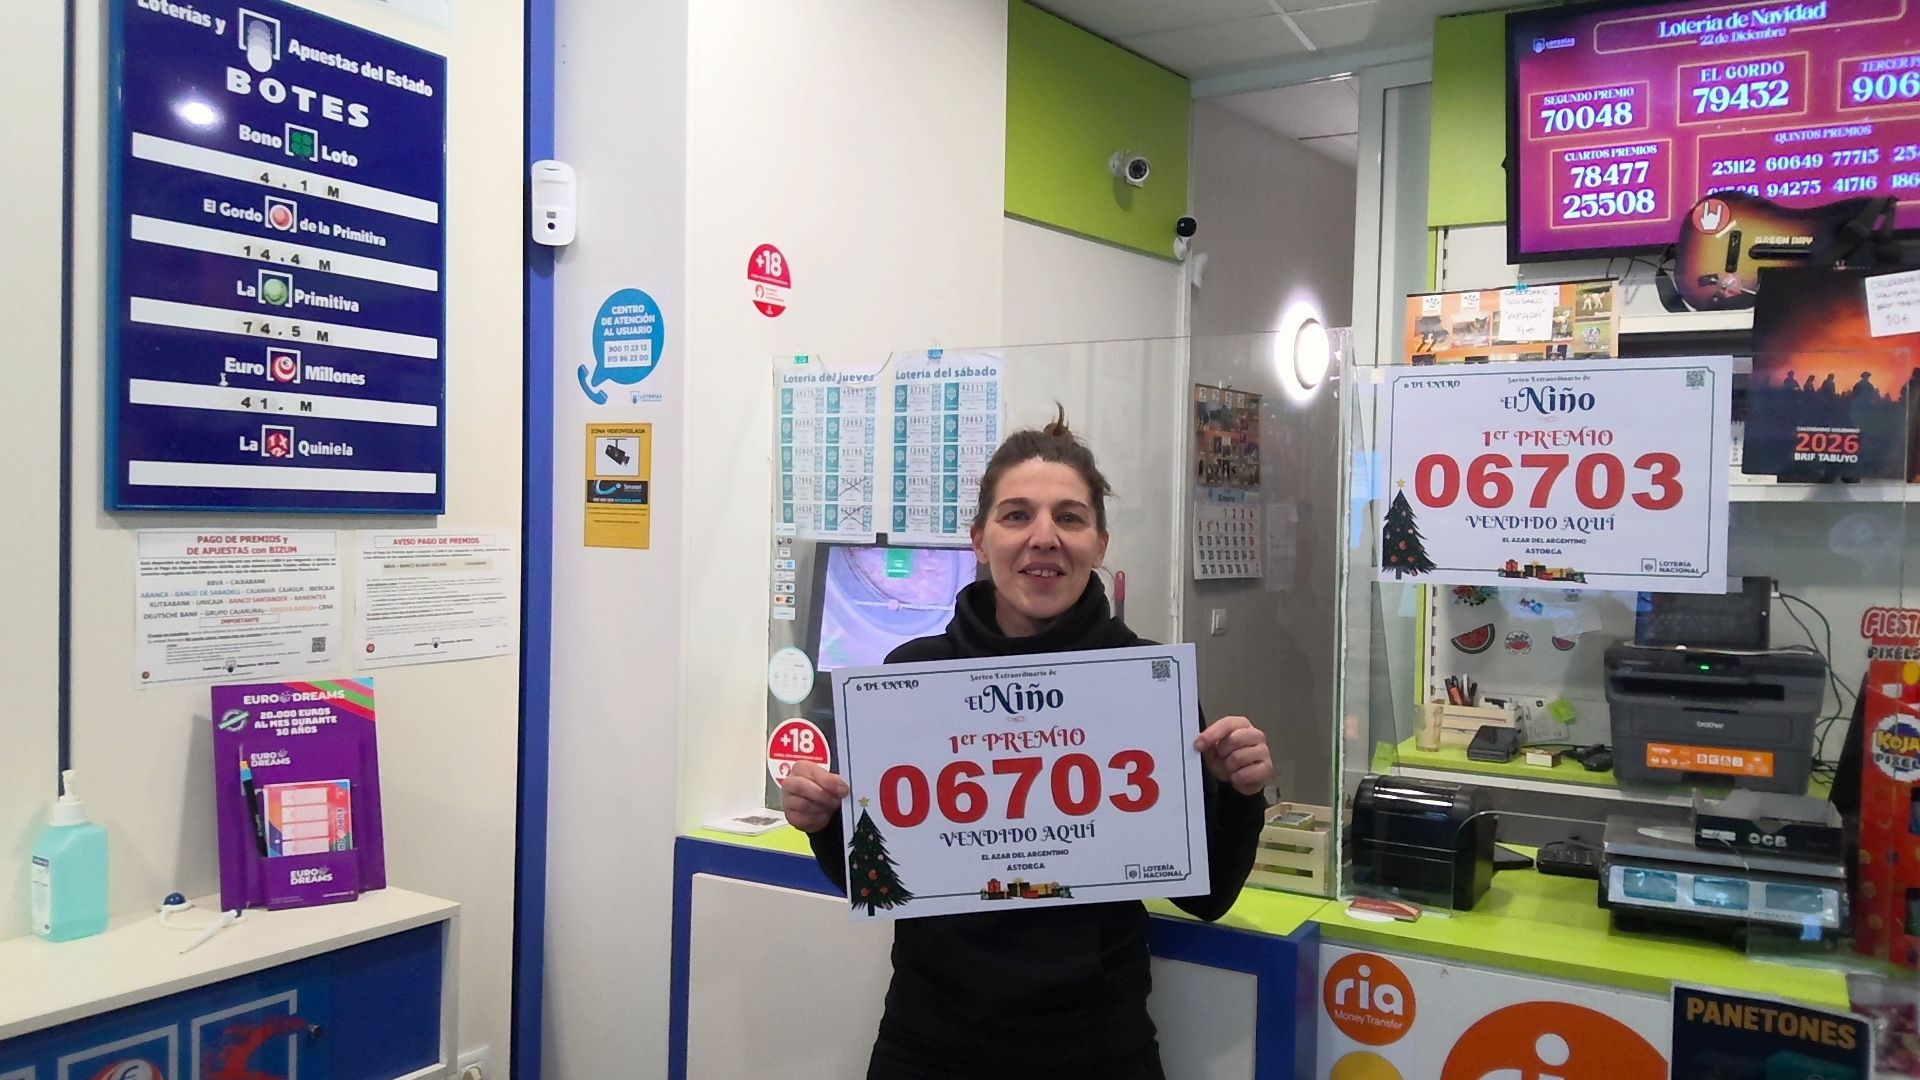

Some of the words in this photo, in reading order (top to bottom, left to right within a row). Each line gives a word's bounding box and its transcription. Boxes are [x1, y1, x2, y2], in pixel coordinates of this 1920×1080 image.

[1725, 12, 1749, 28] de
[1750, 1, 1828, 26] Navidad
[1700, 34, 1714, 46] 22
[1715, 31, 1729, 44] de
[1731, 27, 1787, 42] Diciembre
[137, 0, 211, 26] Loterías
[214, 18, 226, 35] y
[288, 39, 358, 74] Apuestas
[361, 61, 383, 82] del
[386, 71, 433, 97] Estado
[1701, 68, 1722, 82] EL
[1725, 61, 1785, 80] GORDO
[1852, 71, 1920, 102] 906
[227, 66, 369, 128] BOTES
[1544, 91, 1592, 105] SEGUNDO
[1594, 87, 1634, 100] PREMIO
[1692, 79, 1789, 114] 79432
[1540, 101, 1633, 133] 70048
[1775, 128, 1821, 144] QUINTOS
[1823, 125, 1872, 139] PREMIOS
[239, 125, 282, 149] Bono
[322, 145, 358, 167] Loto
[1564, 148, 1610, 161] CUARTOS
[1611, 144, 1657, 157] PREMIOS
[1765, 153, 1823, 172] 60649
[1832, 148, 1879, 166] 77715
[1571, 161, 1649, 188] 78477
[327, 184, 340, 199] M
[1833, 176, 1877, 193] 41716
[1562, 189, 1655, 219] 25508
[203, 198, 216, 213] El
[220, 202, 263, 223] Gordo
[300, 218, 316, 234] de
[318, 221, 330, 236] la
[333, 224, 386, 247] Primitiva
[1755, 235, 1789, 245] GREEN
[319, 258, 331, 272] M
[755, 250, 783, 277] +18
[237, 280, 256, 298] La
[294, 291, 360, 313] Primitiva
[611, 304, 645, 315] CENTRO
[601, 317, 612, 326] DE
[614, 313, 656, 325] ATENCIÓN
[316, 329, 329, 342] M
[604, 328, 615, 336] AL
[616, 325, 653, 336] USUARIO
[224, 357, 265, 376] Euro
[305, 366, 366, 386] Millones
[838, 373, 875, 385] jueves
[895, 369, 931, 380] Lotería
[933, 367, 952, 378] del
[954, 366, 997, 378] sábado
[1411, 381, 1425, 389] DE
[1426, 380, 1461, 389] ENERO
[300, 400, 313, 413] M
[1500, 395, 1518, 410] El
[1517, 385, 1596, 415] Niño
[239, 436, 258, 452] La
[298, 439, 353, 457] Quiniela
[1482, 430, 1509, 447] 1er
[1514, 426, 1614, 449] PREMIO
[1796, 432, 1859, 454] 2026
[1794, 452, 1816, 461] BRIF
[1818, 453, 1858, 463] TABUYO
[1414, 452, 1684, 511] 06703
[1465, 515, 1558, 532] VENDIDO
[1562, 514, 1615, 534] AQUÍ
[197, 535, 223, 544] PAGO
[225, 535, 238, 544] DE
[239, 535, 281, 544] PREMIOS
[186, 547, 200, 555] DE
[202, 546, 249, 555] APUESTAS
[269, 546, 297, 554] BIZUM
[1659, 559, 1692, 567] LOTERÍA
[1864, 609, 1920, 637] FIEST
[970, 673, 993, 682] Sorteo
[996, 670, 1047, 680] Extraordinario
[1048, 669, 1057, 677] de
[856, 683, 862, 691] 6
[864, 682, 879, 691] DE
[881, 680, 919, 690] ENERO
[243, 694, 279, 705] EURO
[292, 690, 345, 702] DREAMS
[964, 694, 983, 710] El
[982, 681, 1064, 714] Niño
[298, 707, 331, 718] EUROS
[254, 721, 268, 729] AL
[270, 719, 290, 728] MES
[291, 715, 338, 727] DURANTE
[276, 728, 289, 736] 30
[291, 725, 318, 735] AÑOS
[780, 729, 815, 753] +18
[948, 732, 978, 754] 1er
[982, 725, 1086, 752] PREMIO
[251, 752, 277, 761] EURO
[251, 757, 291, 767] DREAMS
[879, 749, 1160, 829] 06703
[940, 827, 1038, 848] VENDIDO
[1041, 820, 1096, 844] AQUÍ
[1749, 832, 1787, 847] OCB
[1027, 849, 1070, 858] ARGENTINO
[290, 868, 318, 878] EURO
[1006, 863, 1045, 872] ASTORGA
[1143, 863, 1175, 872] LOTERÍA
[1143, 870, 1183, 879] NACIONAL
[290, 874, 333, 885] DREAMS
[1335, 964, 1404, 1016] ria
[1334, 1009, 1365, 1024] Money
[1366, 1014, 1404, 1029] Transfer
[1687, 997, 1856, 1050] PANETONES
